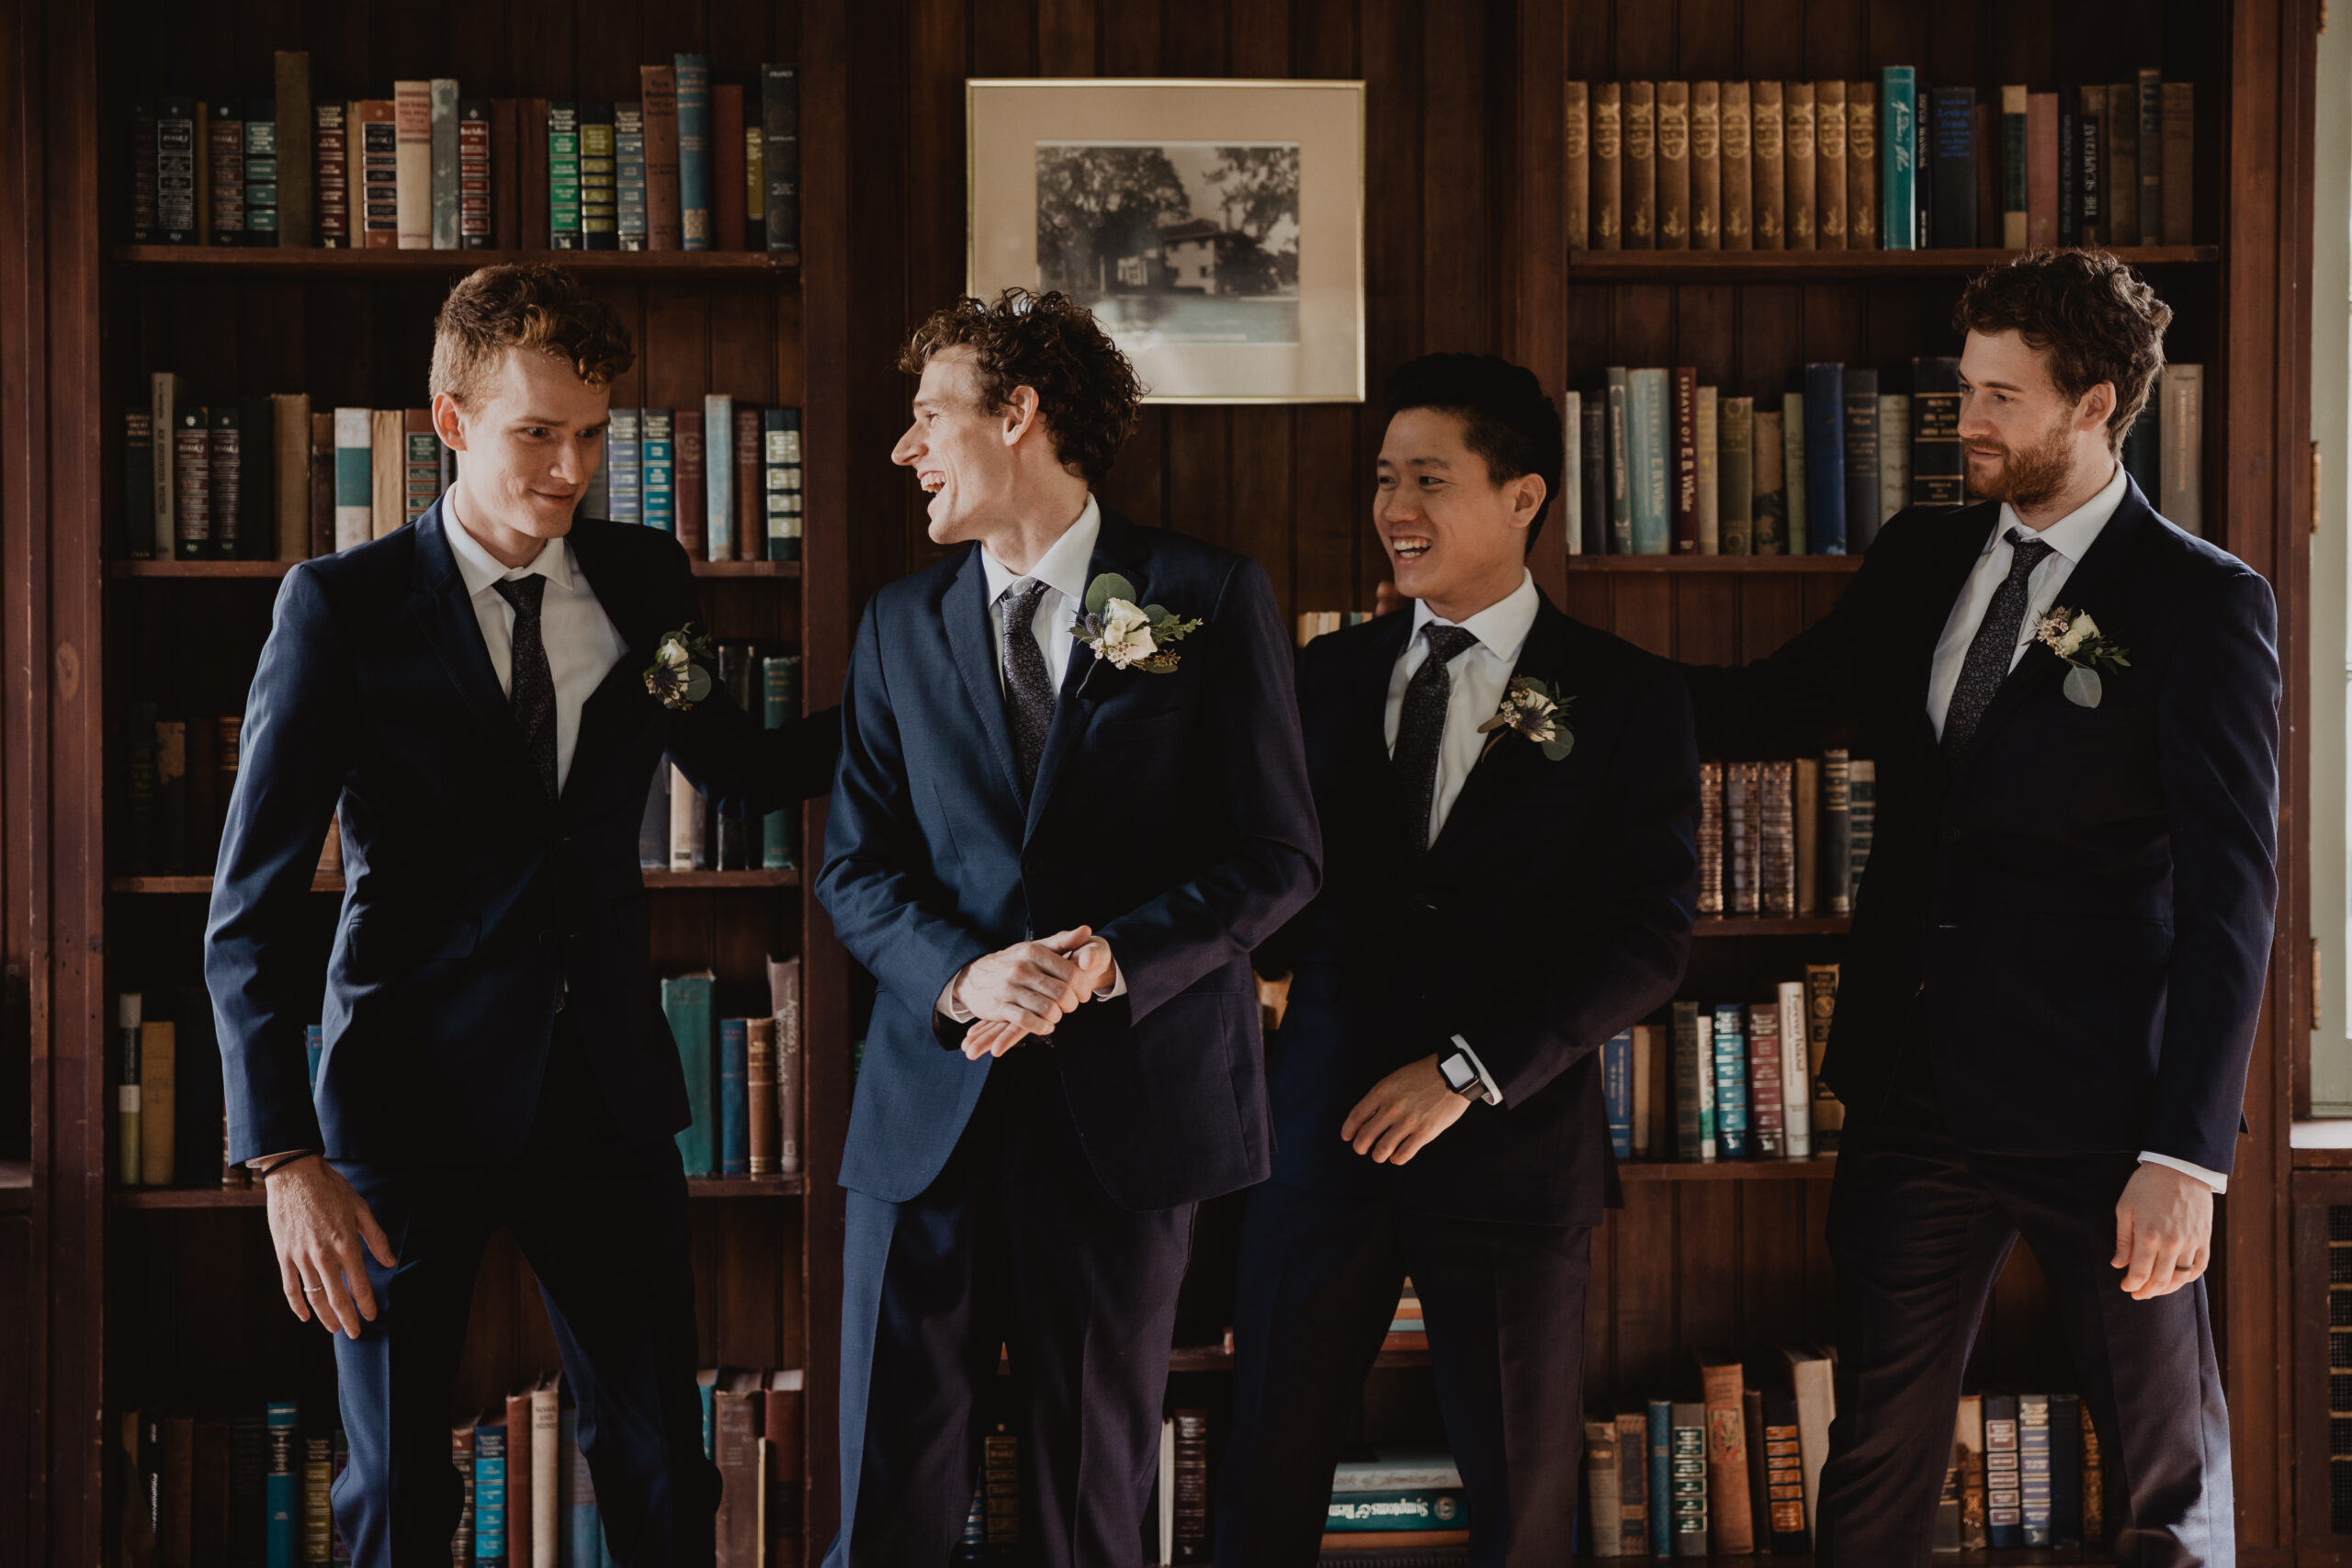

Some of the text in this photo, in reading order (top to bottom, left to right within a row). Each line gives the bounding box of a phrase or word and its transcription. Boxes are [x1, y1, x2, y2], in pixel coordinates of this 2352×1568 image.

[1679, 376, 1690, 423] ESSAYS
[1680, 425, 1691, 444] OF
[1680, 474, 1695, 513] White
[1792, 993, 1804, 1072] Forever Island
[1354, 1503, 1372, 1520] &
[1371, 1496, 1429, 1518] Symptoms
